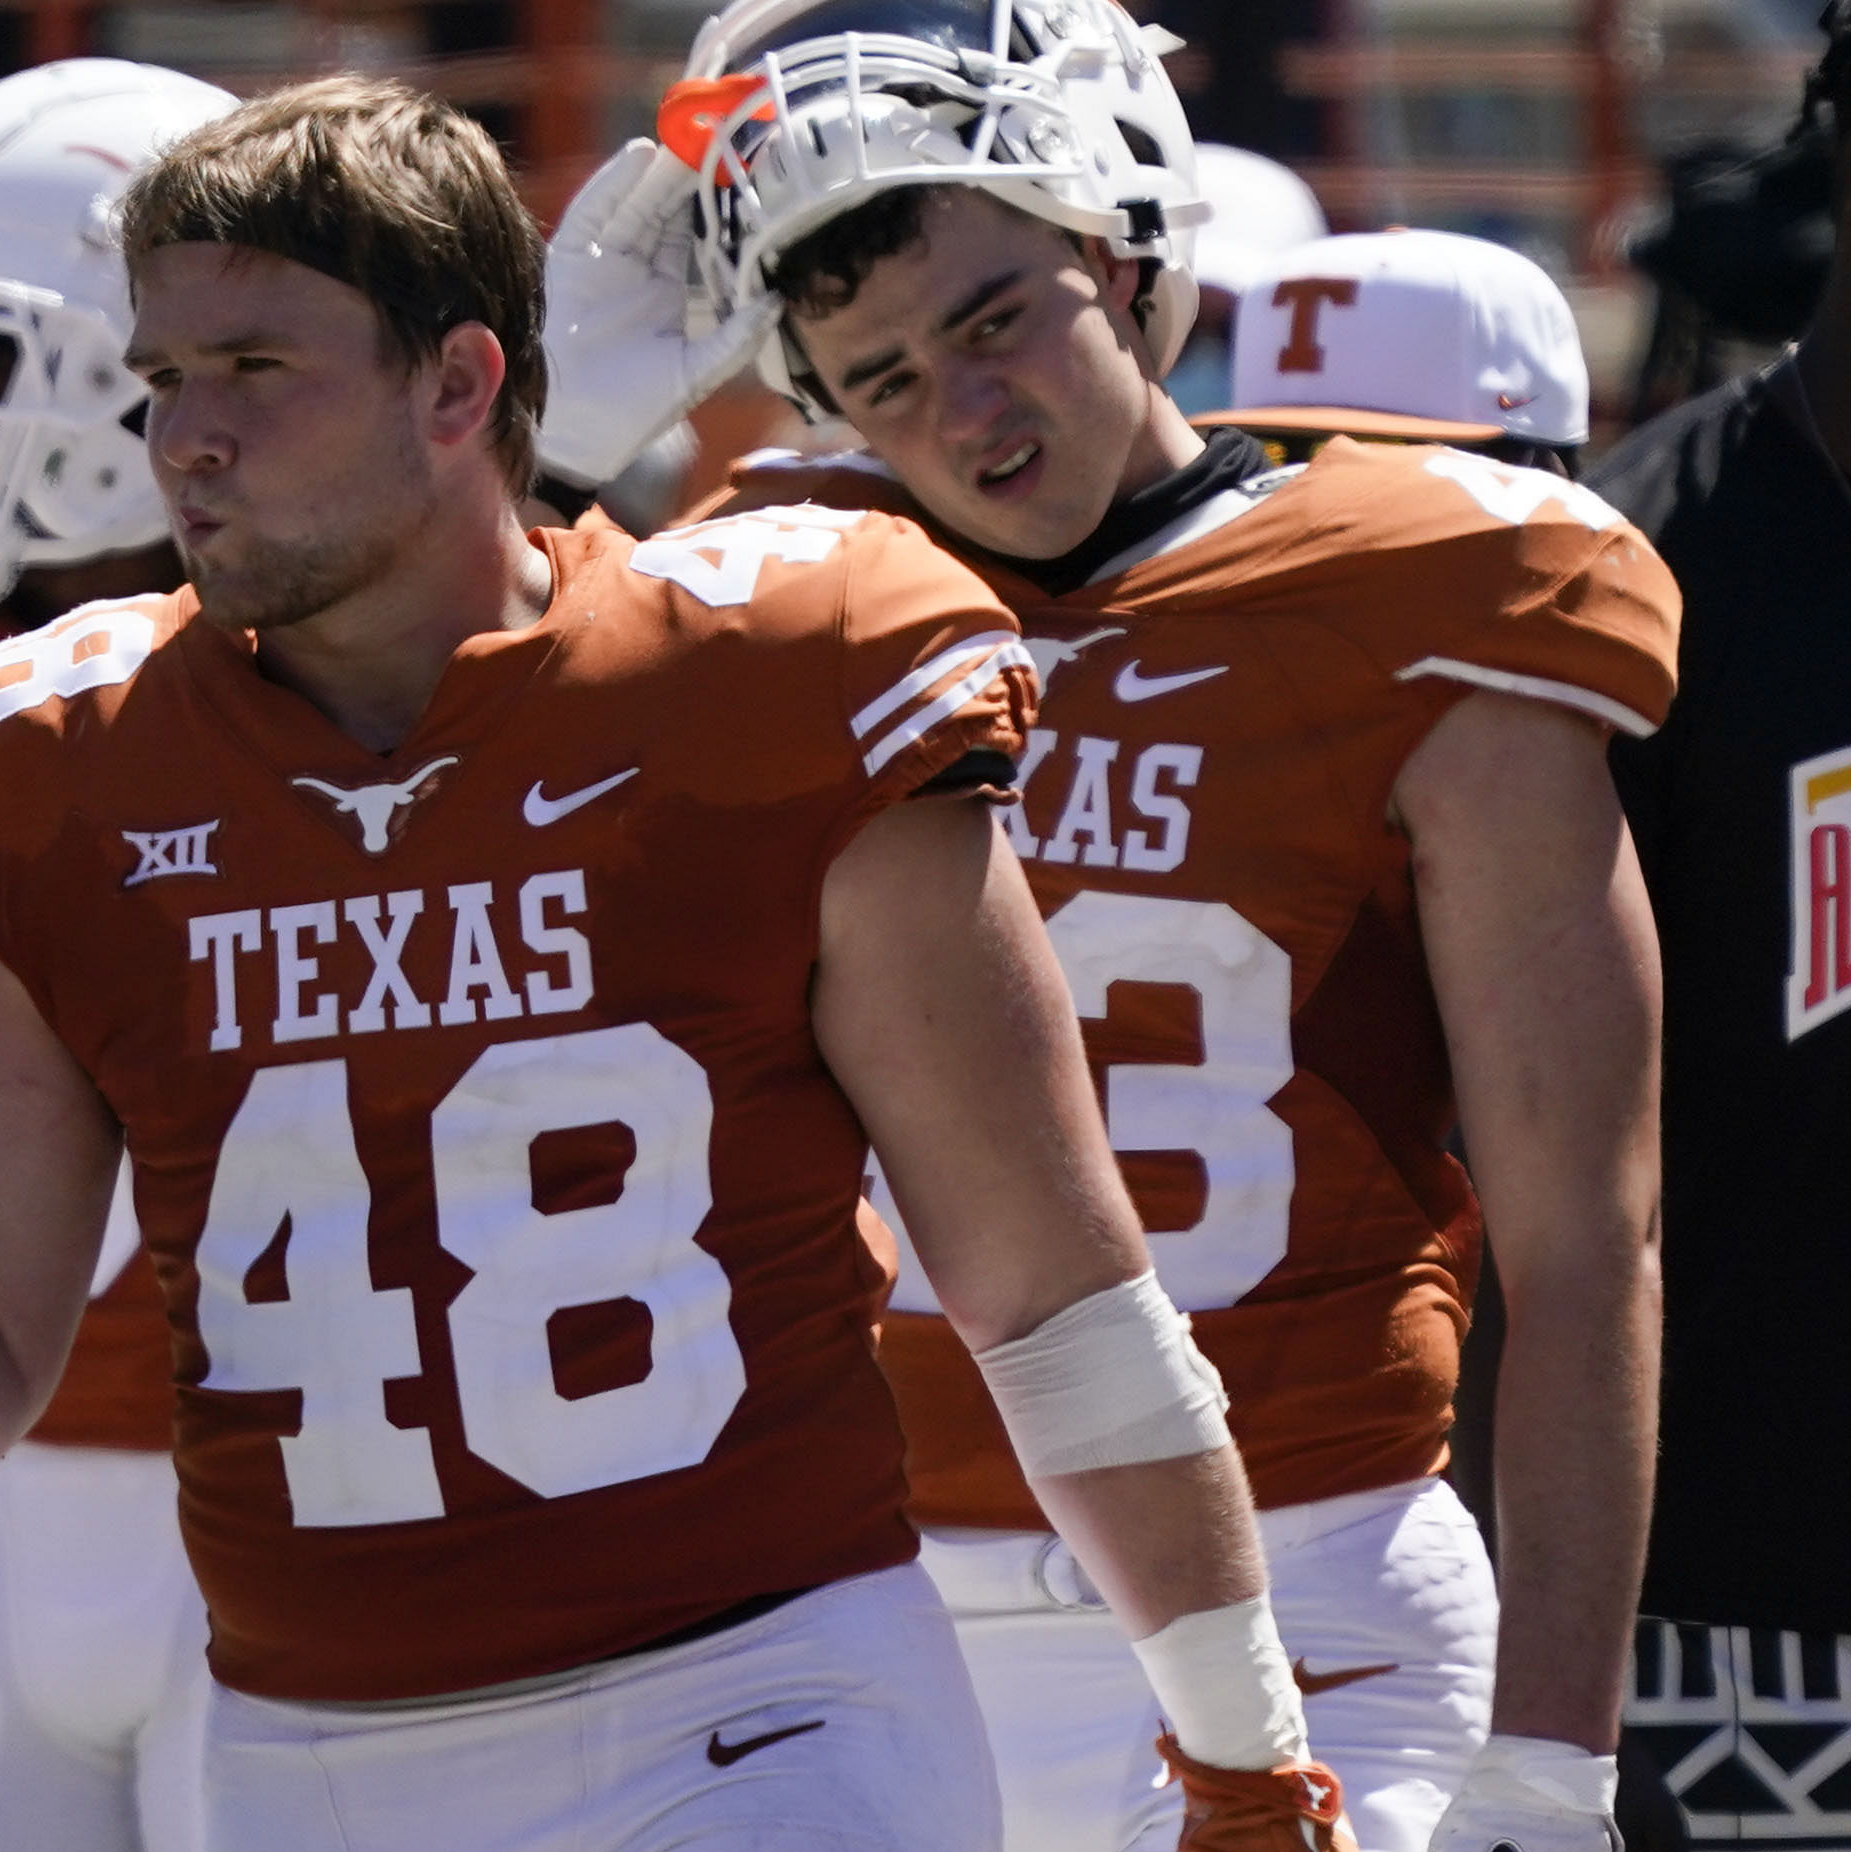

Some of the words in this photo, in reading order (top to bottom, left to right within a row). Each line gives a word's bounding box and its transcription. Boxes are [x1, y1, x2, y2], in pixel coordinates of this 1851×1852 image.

[1270, 278, 1358, 373] T
[983, 729, 1205, 873] XAS
[188, 869, 595, 1053] TEXAS
[195, 1021, 748, 1528] 48
